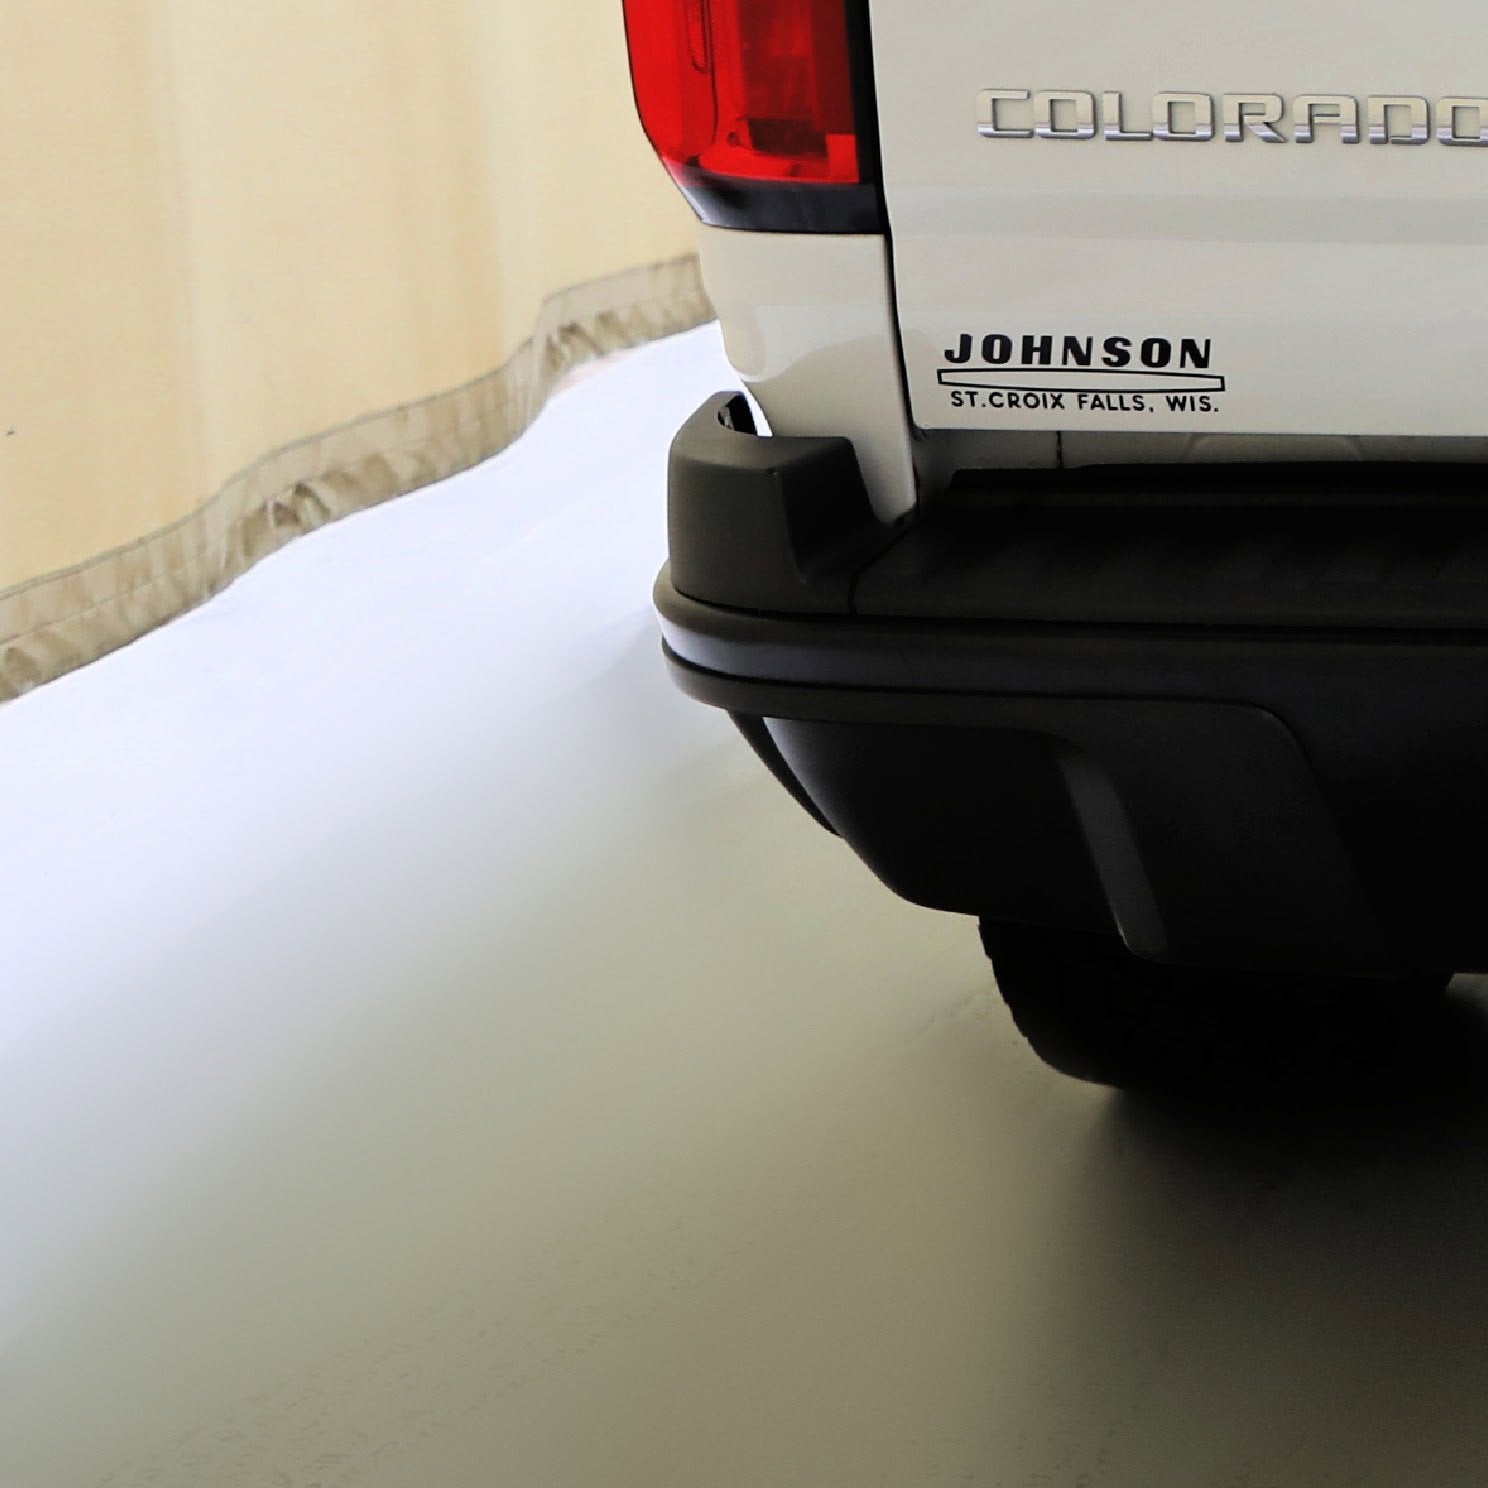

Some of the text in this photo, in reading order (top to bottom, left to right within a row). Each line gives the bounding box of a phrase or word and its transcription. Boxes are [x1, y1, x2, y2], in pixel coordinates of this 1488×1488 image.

[944, 333, 1212, 369] JOHNSON
[1077, 393, 1155, 413] FALLS,
[1165, 395, 1219, 413] WIS.
